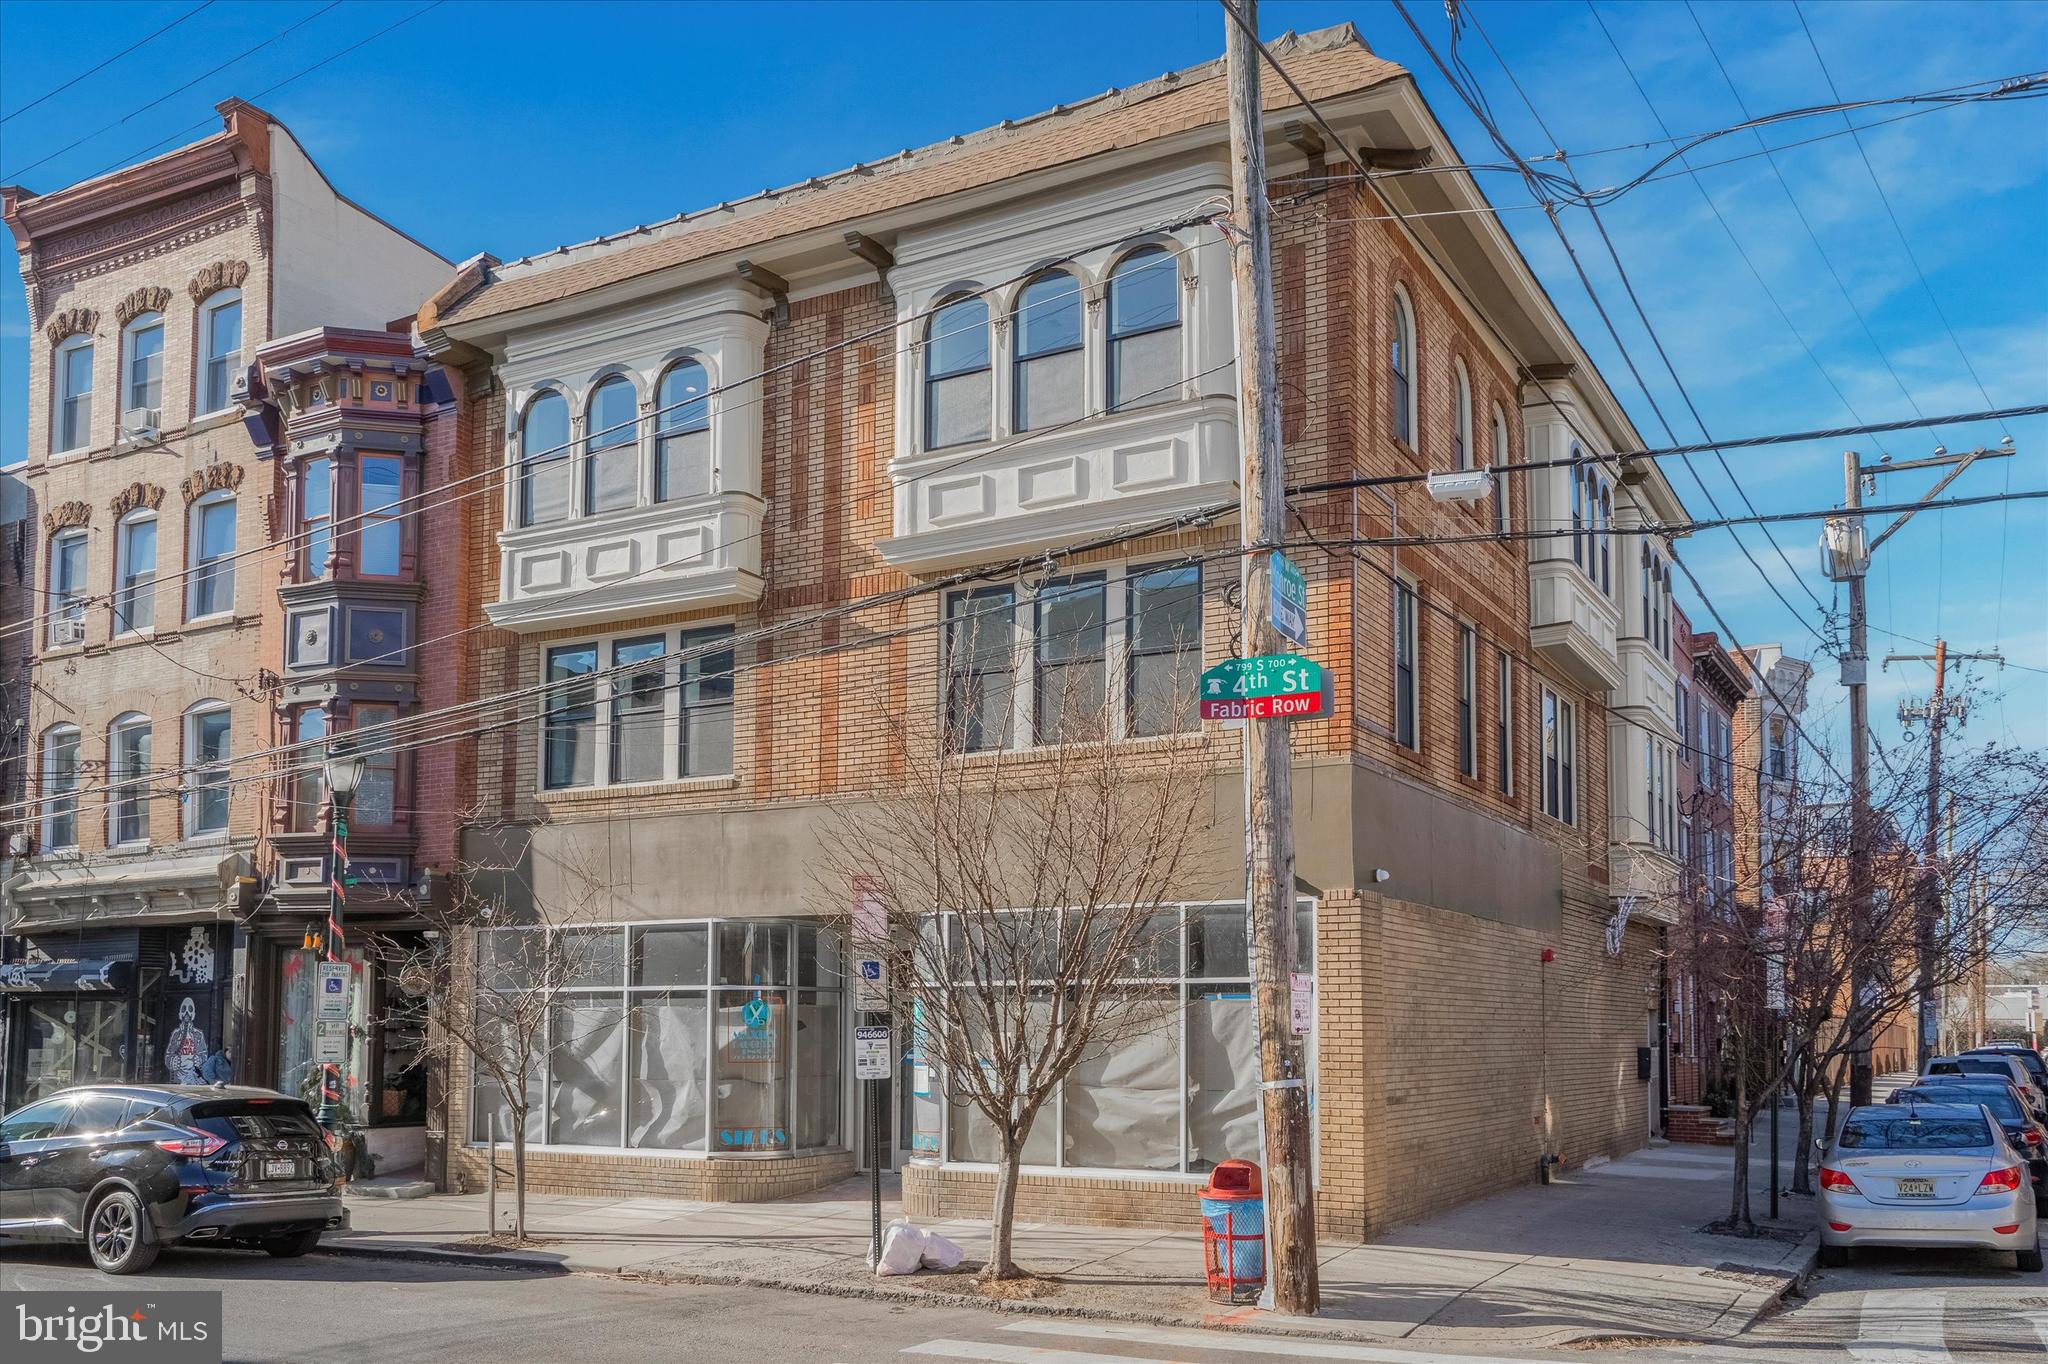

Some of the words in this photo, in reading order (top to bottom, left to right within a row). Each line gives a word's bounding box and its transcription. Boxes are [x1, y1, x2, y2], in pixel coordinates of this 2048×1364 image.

[1298, 584, 1306, 608] St
[1236, 662, 1252, 671] 799
[1256, 660, 1264, 671] S
[1268, 659, 1286, 668] 700
[1232, 672, 1268, 696] 4th
[1282, 668, 1309, 692] St
[1210, 699, 1265, 718] Fabric
[1272, 698, 1311, 714] Row
[319, 1023, 324, 1035] 2
